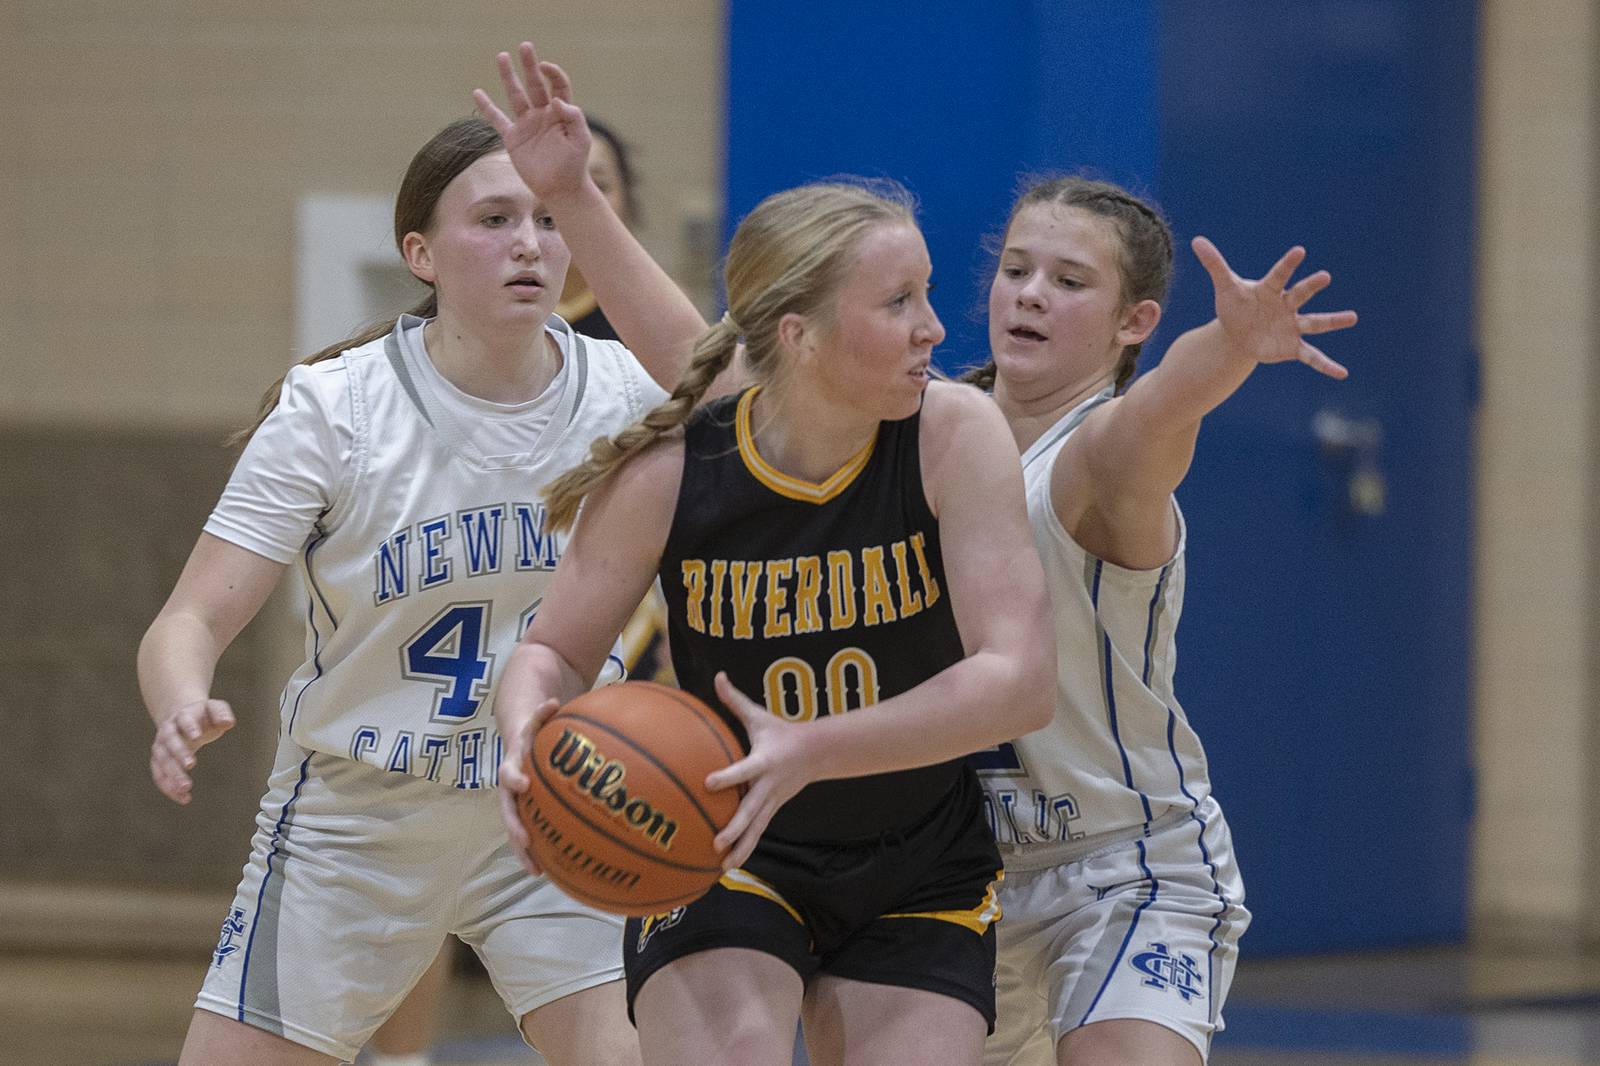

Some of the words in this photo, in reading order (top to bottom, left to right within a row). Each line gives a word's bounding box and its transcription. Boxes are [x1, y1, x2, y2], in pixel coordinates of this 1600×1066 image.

[398, 597, 543, 724] 4
[763, 646, 881, 724] 00
[351, 725, 503, 790] CATH
[549, 728, 680, 851] Wilson
